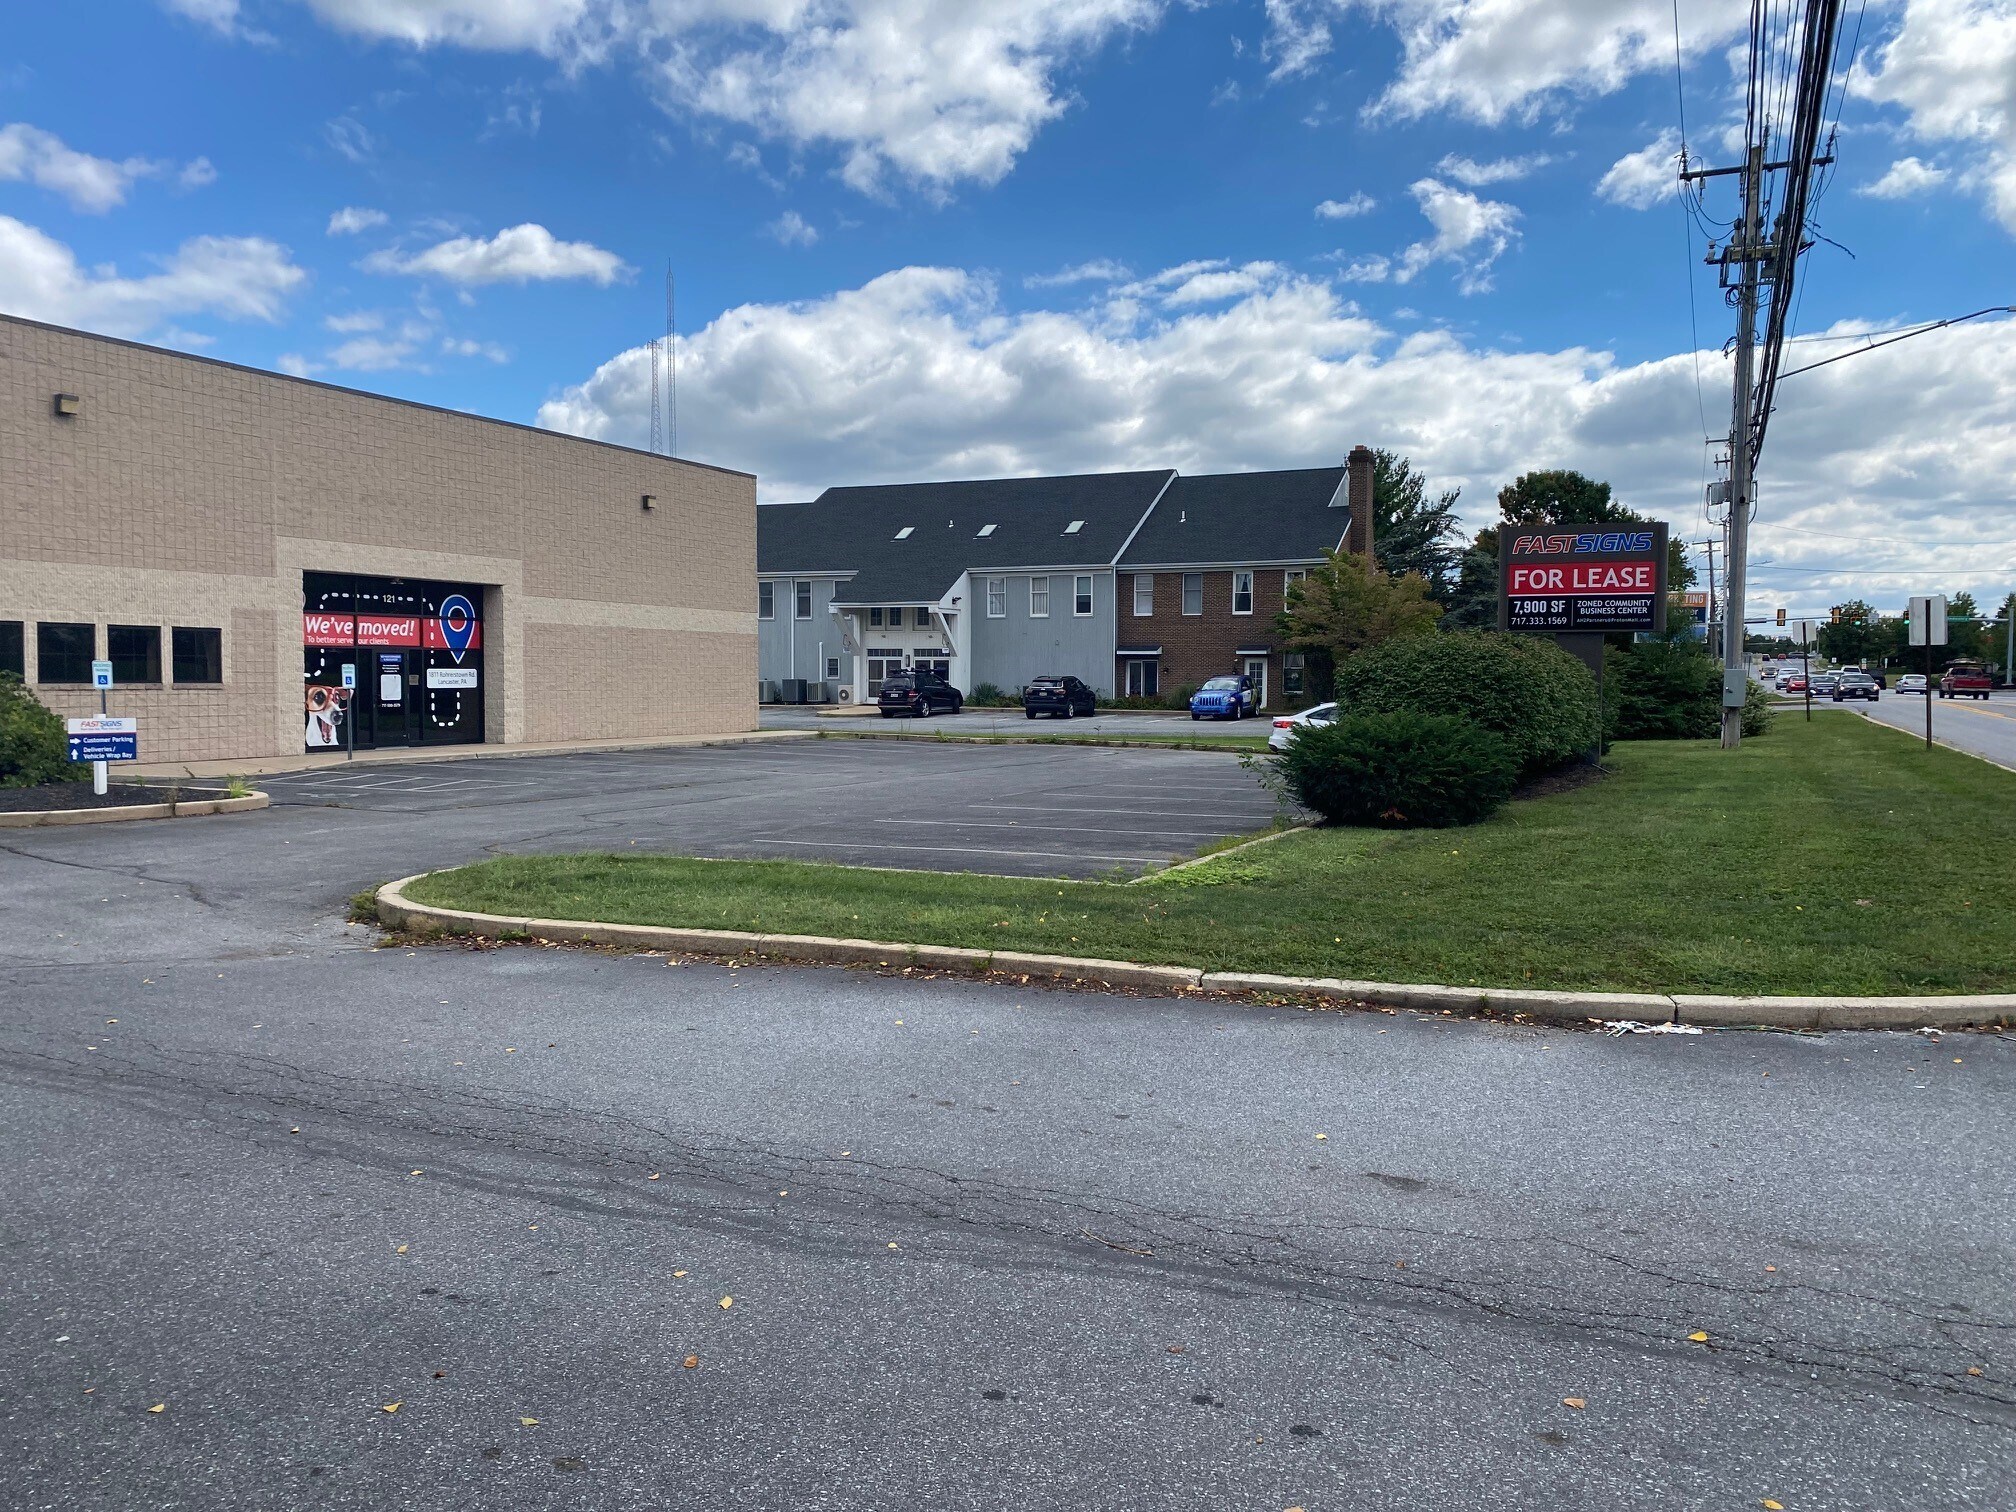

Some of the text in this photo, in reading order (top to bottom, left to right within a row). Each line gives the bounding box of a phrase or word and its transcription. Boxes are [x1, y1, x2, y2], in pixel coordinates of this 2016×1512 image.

[1512, 532, 1653, 554] FASTSIGNS
[1514, 567, 1650, 590] FOR LEASE
[382, 595, 395, 603] 121
[1605, 599, 1652, 607] COMMUNITY
[1514, 600, 1566, 615] 7,900 SF
[1580, 607, 1615, 615] BUSINESS
[305, 616, 415, 637] We've moved!
[1511, 617, 1567, 625] 717.333.1569
